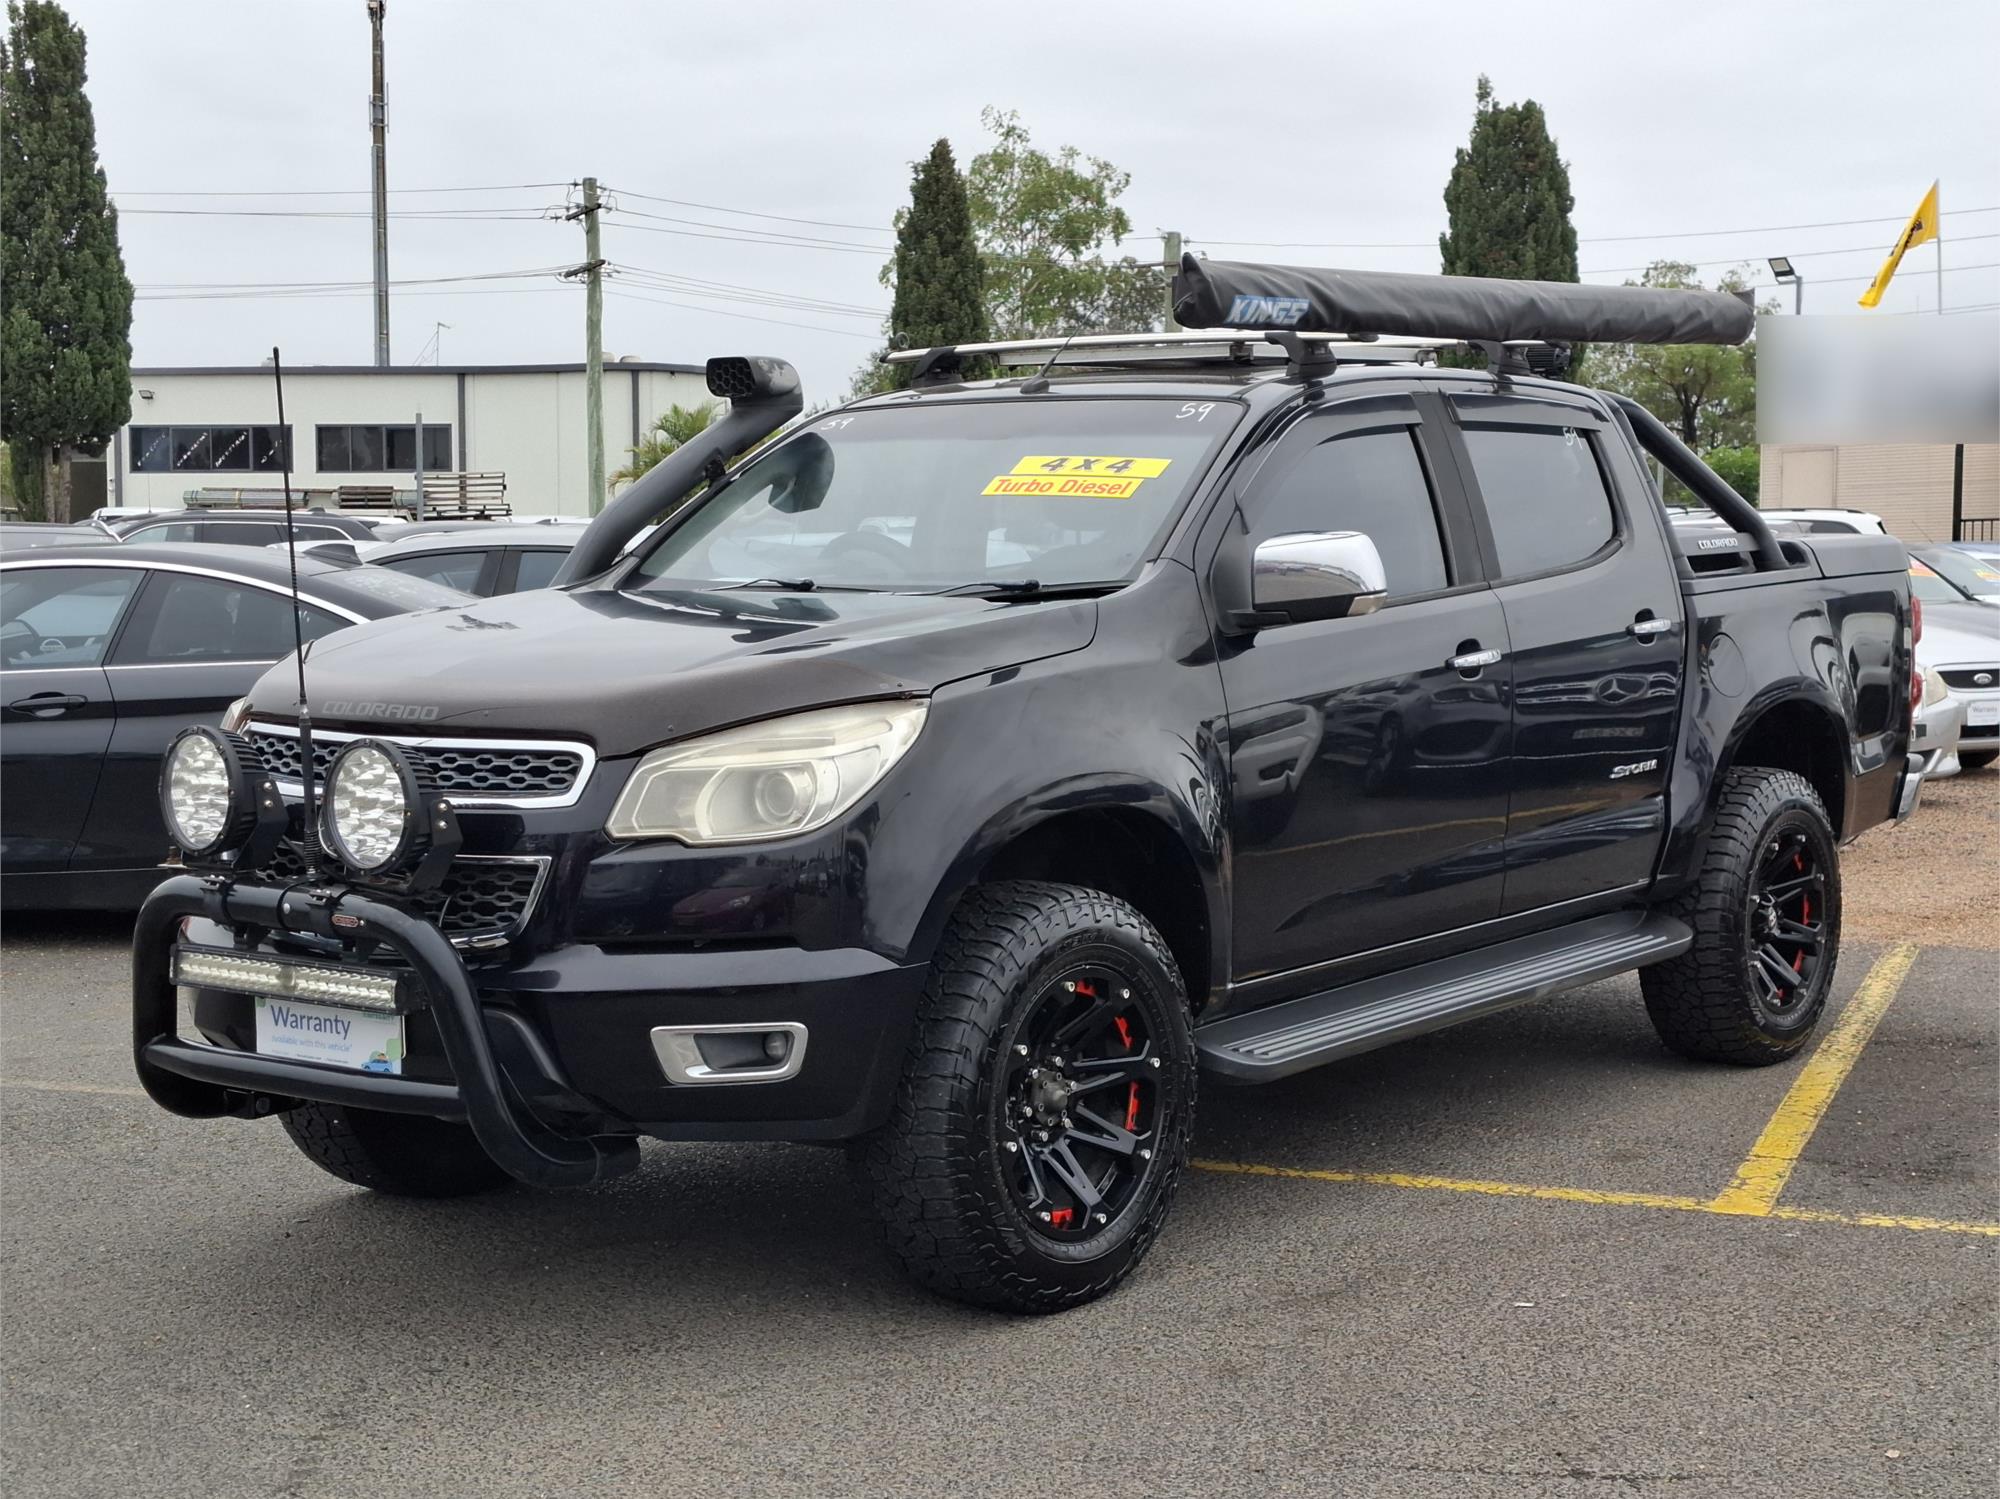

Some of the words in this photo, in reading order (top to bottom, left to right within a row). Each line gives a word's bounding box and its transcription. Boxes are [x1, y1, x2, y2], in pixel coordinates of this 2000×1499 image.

[1224, 299, 1310, 325] KINGS
[1175, 402, 1216, 422] 59
[993, 479, 1055, 494] Turbo
[1057, 479, 1133, 496] Diesel
[1697, 537, 1738, 550] COLORADO
[321, 700, 439, 720] COLORADO
[270, 1004, 351, 1040] Warranty
